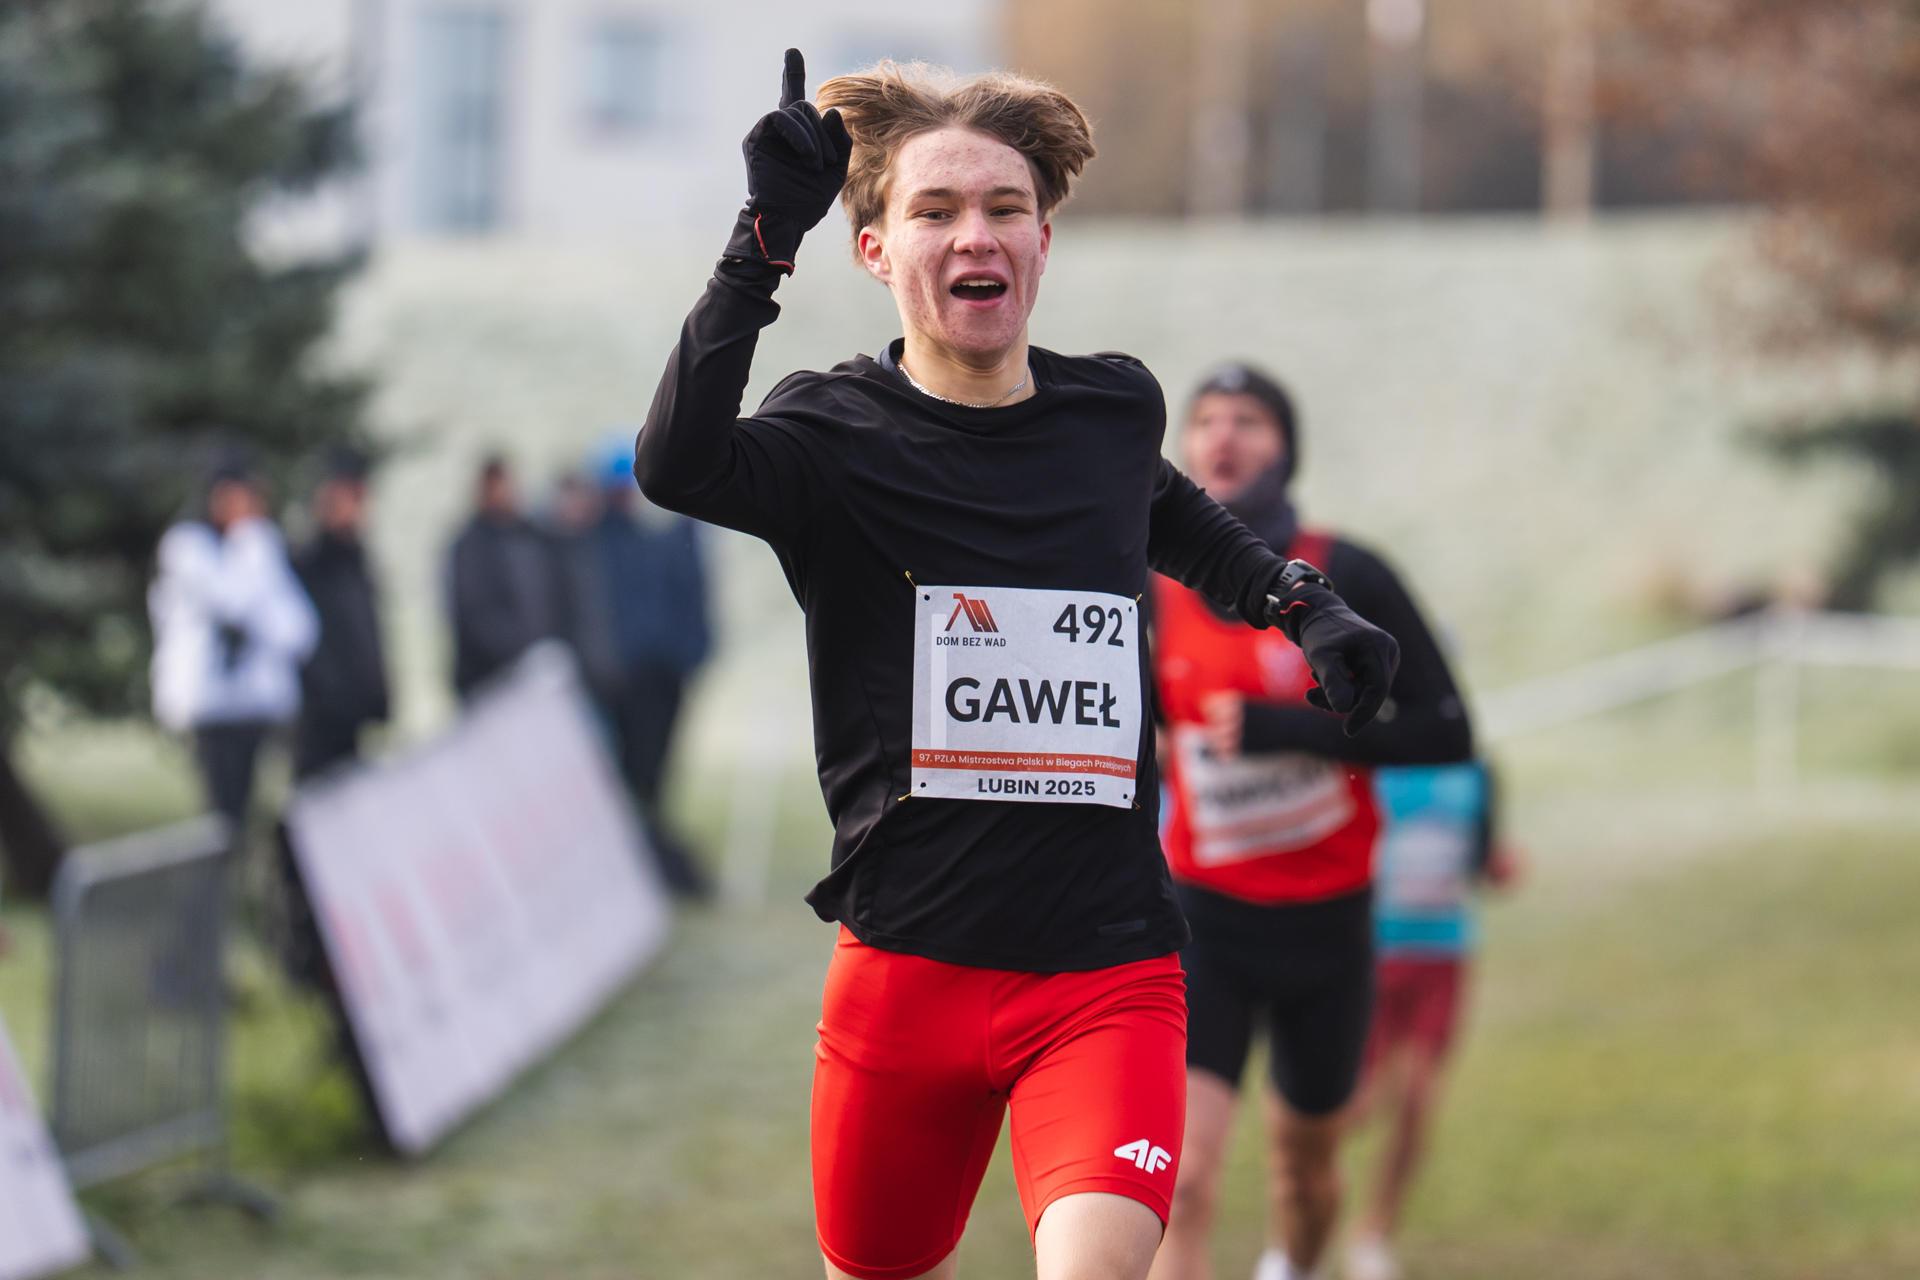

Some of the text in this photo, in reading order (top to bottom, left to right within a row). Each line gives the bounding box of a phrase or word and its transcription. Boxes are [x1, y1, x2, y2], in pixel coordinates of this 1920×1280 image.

[1052, 604, 1124, 647] 492
[936, 637, 1006, 647] DOM BEZ WAD
[945, 677, 1120, 728] GAWEŁ
[919, 754, 932, 762] 97.
[934, 754, 956, 763] PZLA
[959, 755, 1014, 765] Mistrzostwa
[1017, 757, 1043, 766] Polski
[1056, 758, 1093, 769] Biegach
[978, 778, 1095, 796] LUBIN 2025
